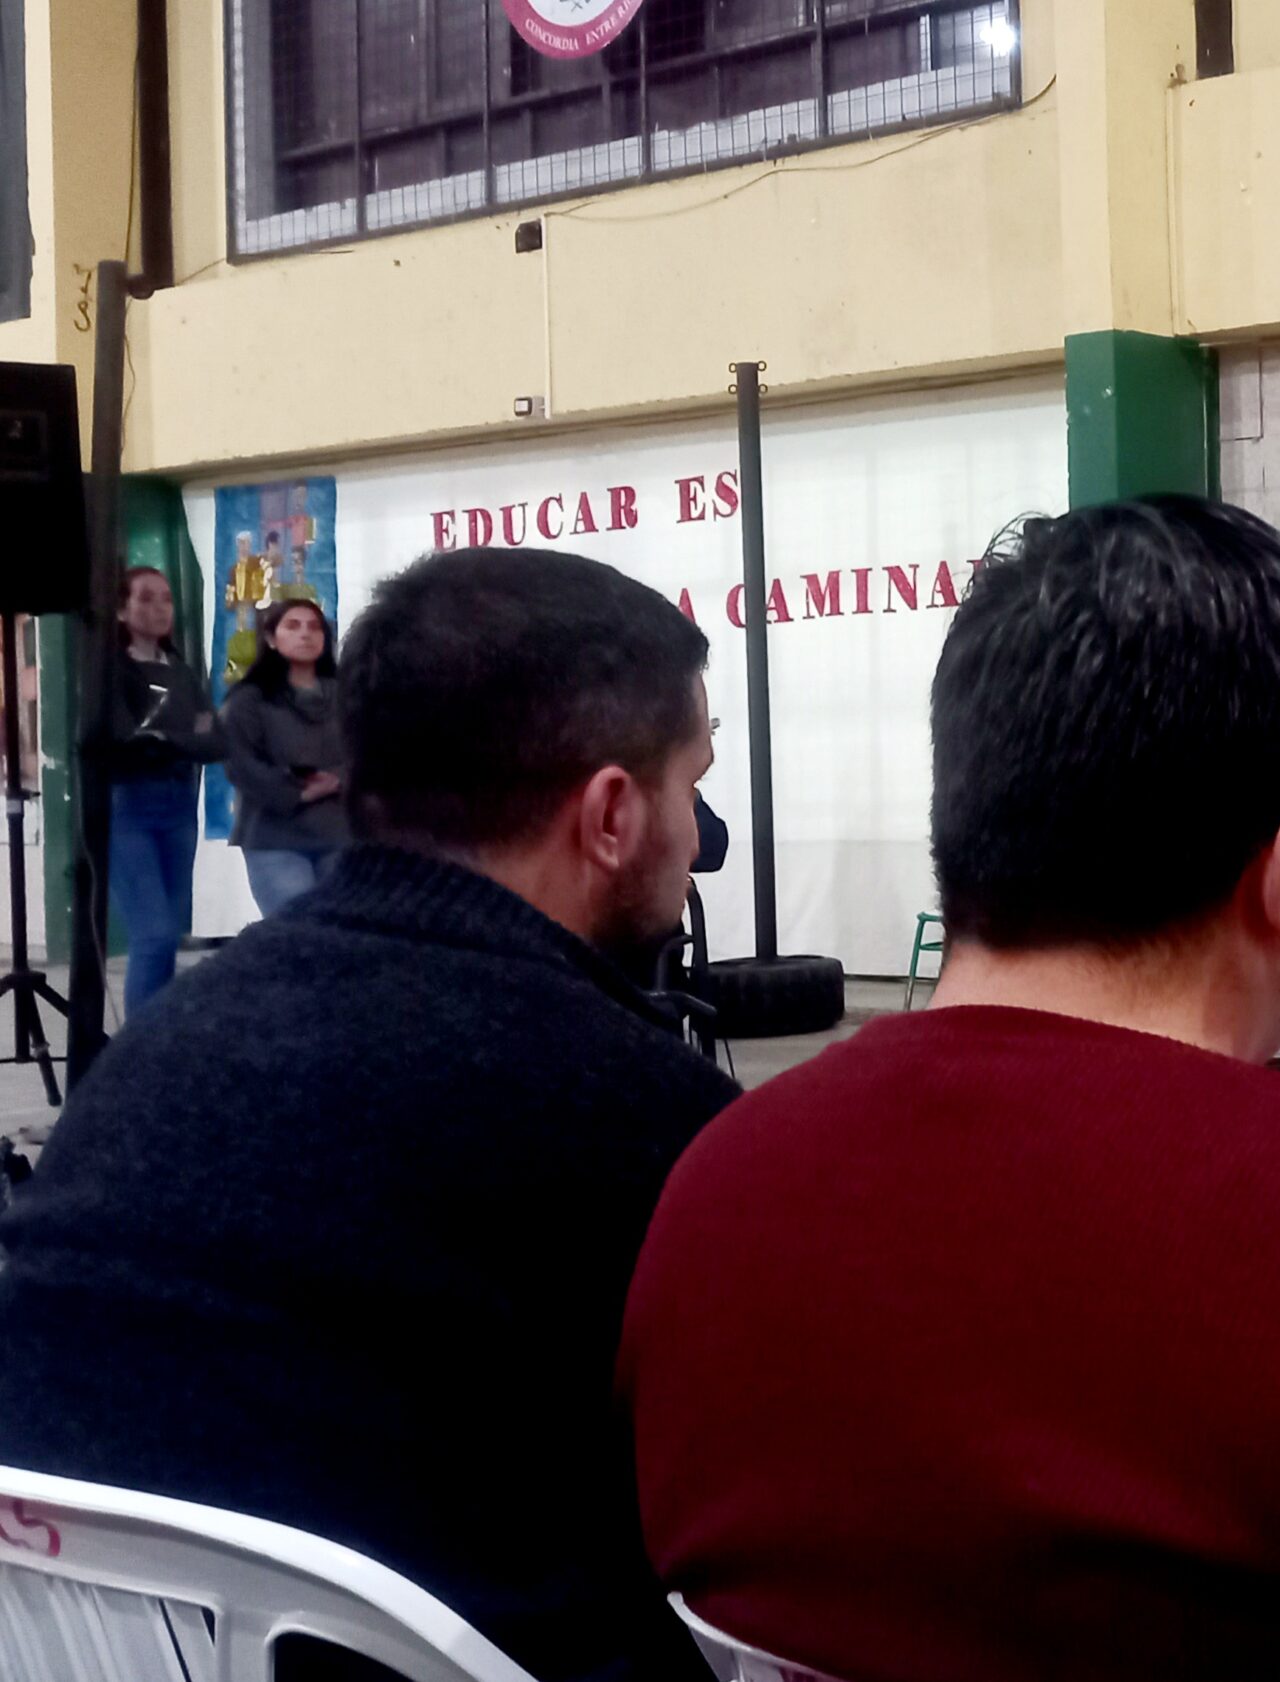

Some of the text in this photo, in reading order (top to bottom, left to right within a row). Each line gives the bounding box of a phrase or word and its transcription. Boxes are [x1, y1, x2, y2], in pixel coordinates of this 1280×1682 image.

[525, 18, 579, 50] CONCORDIA
[585, 13, 617, 45] ENTRE
[430, 469, 739, 554] EDUCAR ES
[726, 559, 983, 628] CAMINA
